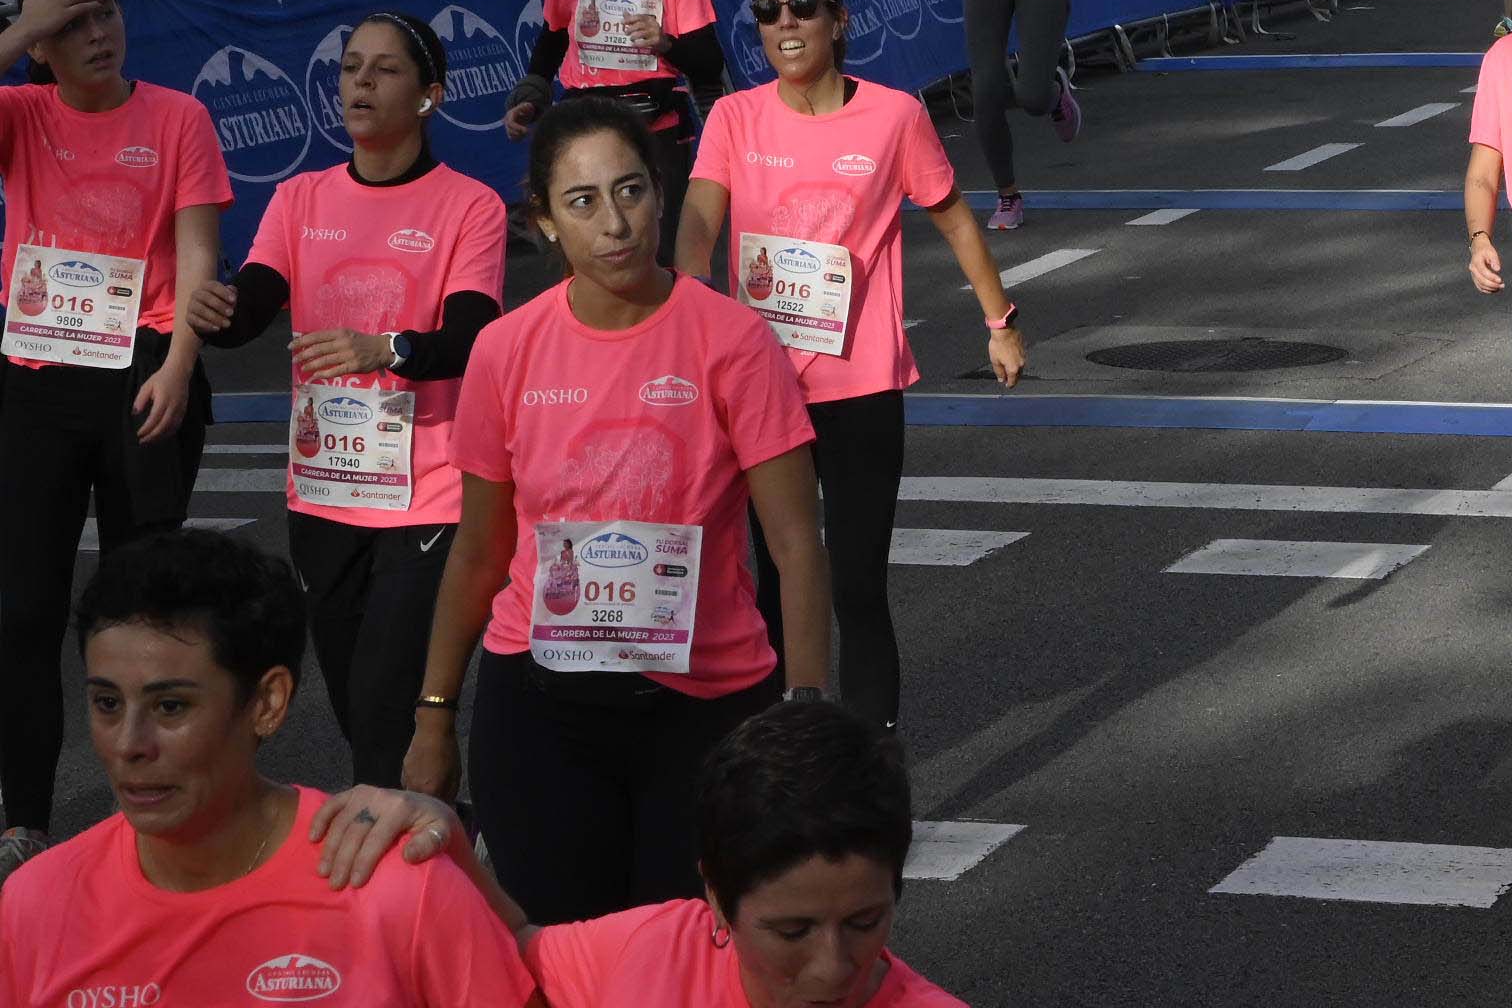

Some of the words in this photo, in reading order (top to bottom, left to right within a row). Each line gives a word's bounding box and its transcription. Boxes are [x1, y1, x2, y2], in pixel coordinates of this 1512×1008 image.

[746, 151, 794, 169] OYSHO
[777, 254, 818, 271] ASTURIANA
[51, 267, 100, 284] ASTURIANA
[108, 270, 134, 281] SUMA
[775, 279, 812, 299] 016
[51, 294, 94, 313] 016
[776, 300, 804, 313] 12522
[56, 315, 83, 328] 9809
[777, 313, 785, 321] DE
[795, 316, 818, 326] MUJER
[19, 325, 53, 336] CARRERA
[54, 329, 64, 338] DE
[65, 331, 76, 339] LA
[77, 332, 103, 342] MUJER
[104, 336, 121, 344] 2023
[800, 332, 836, 345] Santander
[14, 340, 52, 353] OYSHO
[82, 348, 122, 361] Santander
[523, 387, 589, 406] OYSHO
[642, 387, 694, 400] ASTURIANA
[321, 405, 369, 420] ASTURIANA
[324, 433, 365, 453] 016
[329, 456, 360, 469] 17940
[300, 467, 330, 479] CARRERA
[330, 472, 340, 480] DE
[341, 473, 351, 481] LA
[352, 474, 378, 482] MUJER
[381, 476, 397, 484] 2023
[299, 482, 330, 497] OYSHO
[361, 490, 401, 501] Santander
[584, 545, 642, 561] ASTURIANA
[655, 544, 688, 555] SUMA
[584, 581, 637, 603] 016
[591, 609, 624, 623] 3268
[550, 629, 591, 638] CARRERA
[593, 630, 605, 638] DE
[606, 630, 616, 638] LA
[617, 631, 649, 640] MUJER
[652, 632, 675, 641] 2023
[543, 649, 594, 661] OYSHO
[629, 650, 676, 661] Santander
[253, 973, 335, 992] ASTURIANA
[66, 981, 161, 1008] OYSHO
